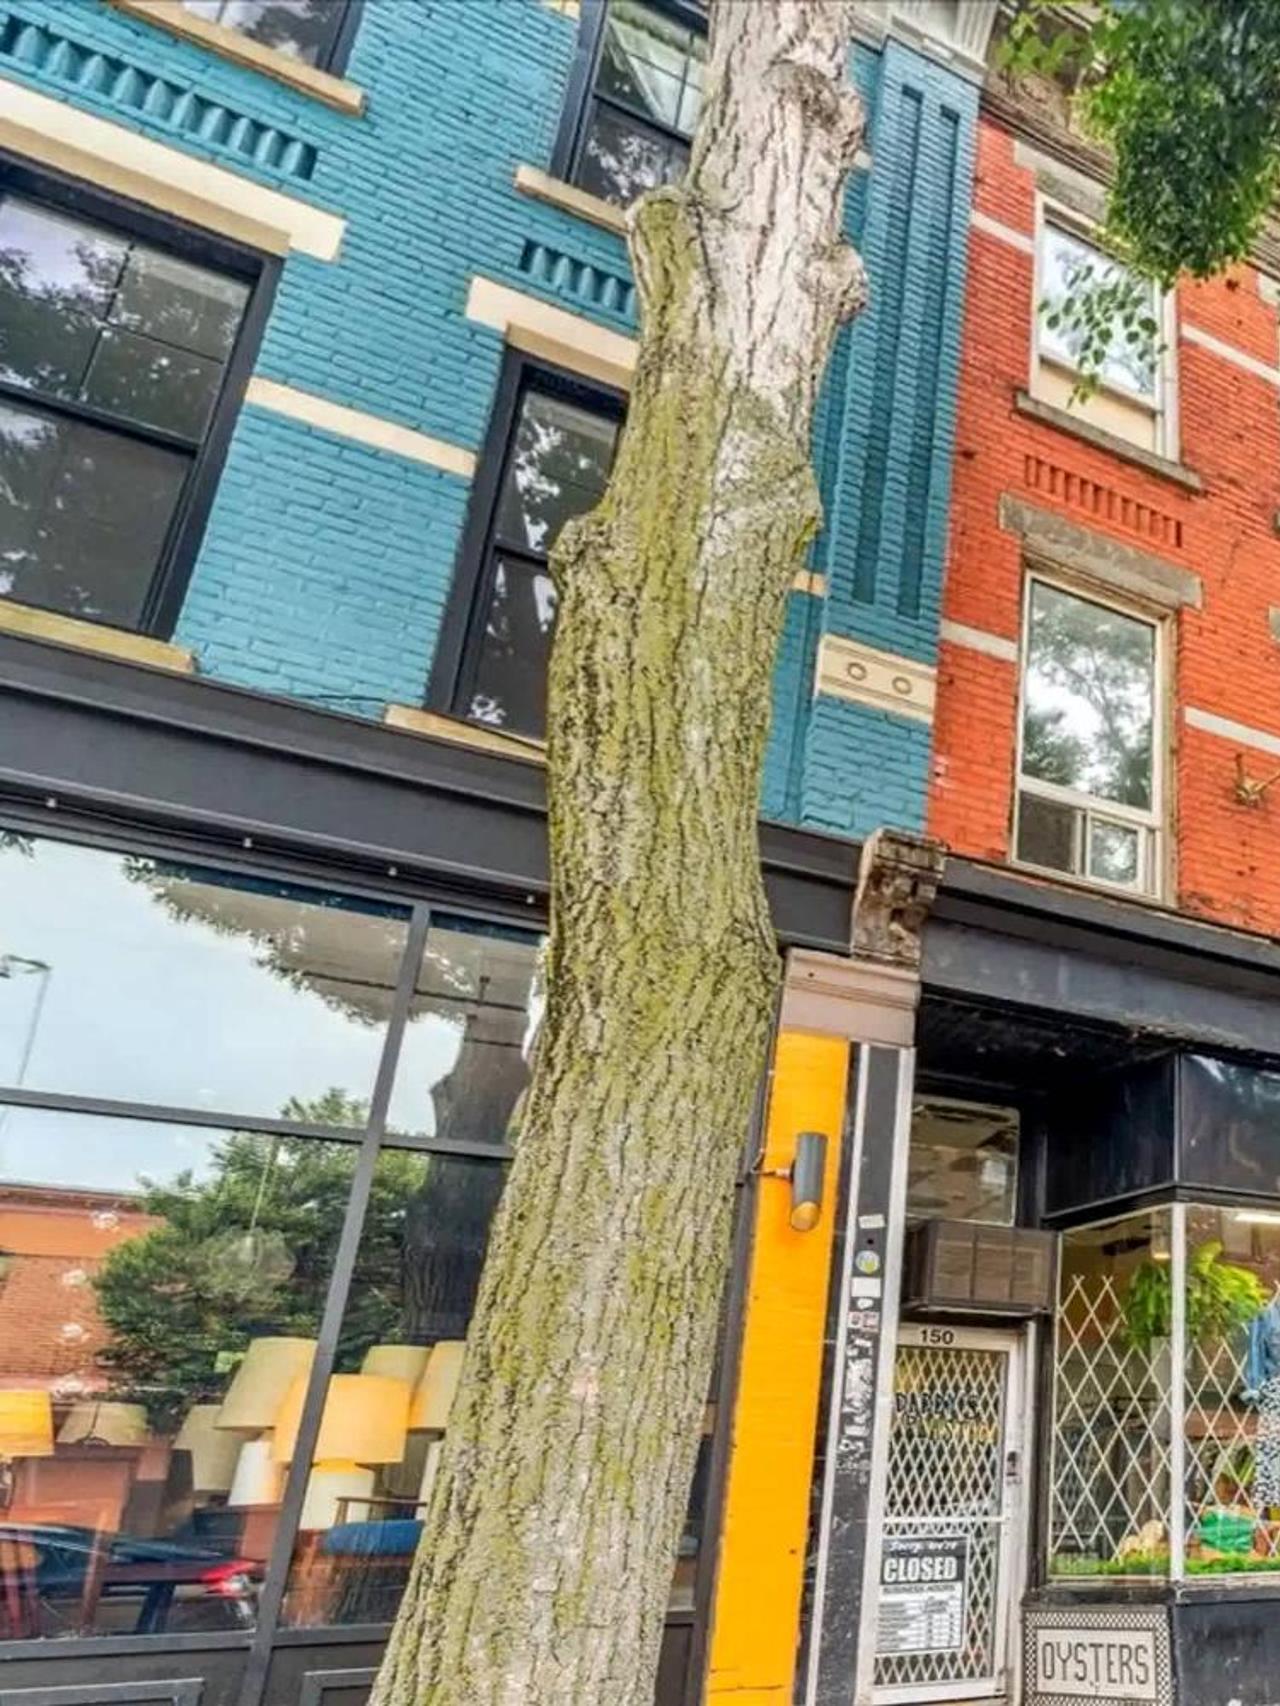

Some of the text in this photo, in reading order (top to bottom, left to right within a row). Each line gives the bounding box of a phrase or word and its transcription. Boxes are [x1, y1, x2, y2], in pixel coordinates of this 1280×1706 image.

[921, 1328, 955, 1345] 150
[883, 1556, 958, 1583] CLOSED
[1042, 1641, 1150, 1685] OYSTERS
